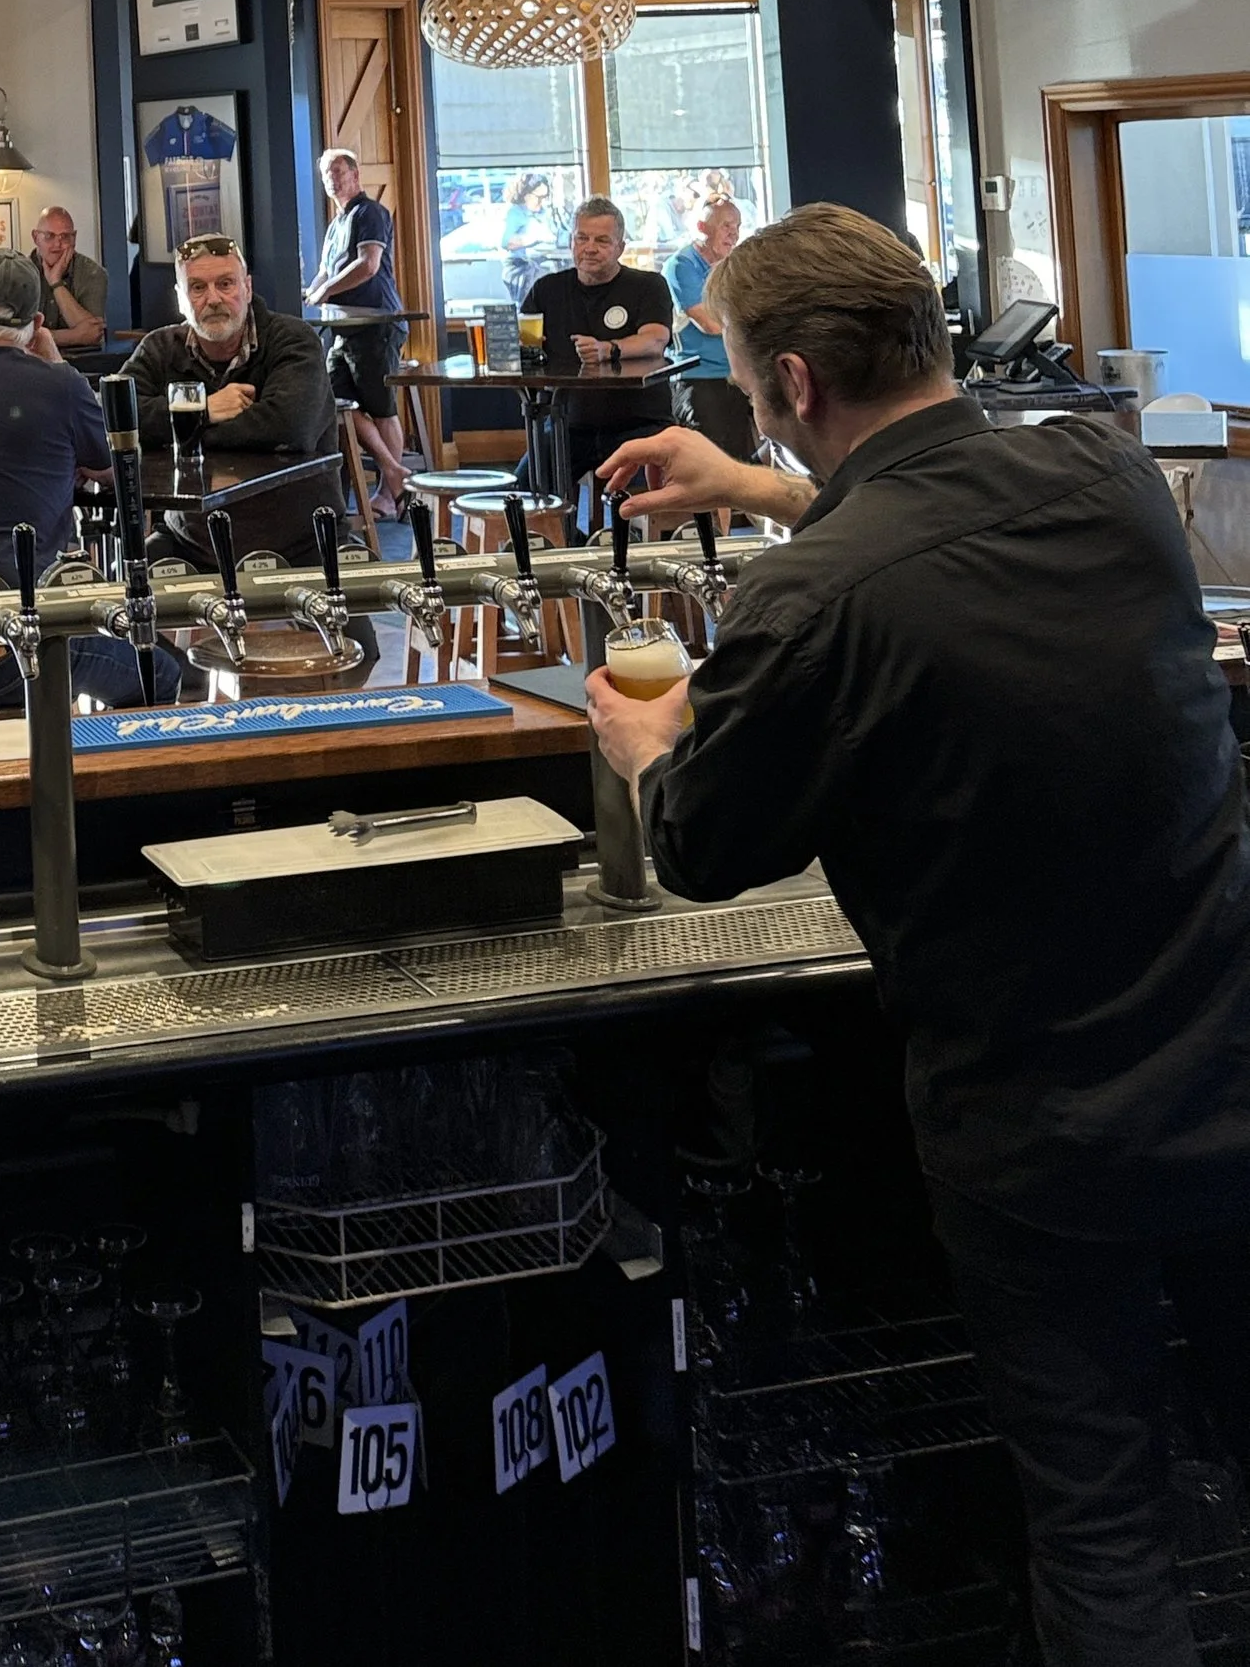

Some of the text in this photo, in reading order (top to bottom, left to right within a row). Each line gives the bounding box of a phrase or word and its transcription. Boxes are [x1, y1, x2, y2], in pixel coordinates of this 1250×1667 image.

[113, 695, 444, 736] Canadian Club
[364, 1316, 405, 1399] 110
[348, 1421, 409, 1496] 105
[498, 1385, 546, 1474] 108
[557, 1373, 609, 1464] 102
